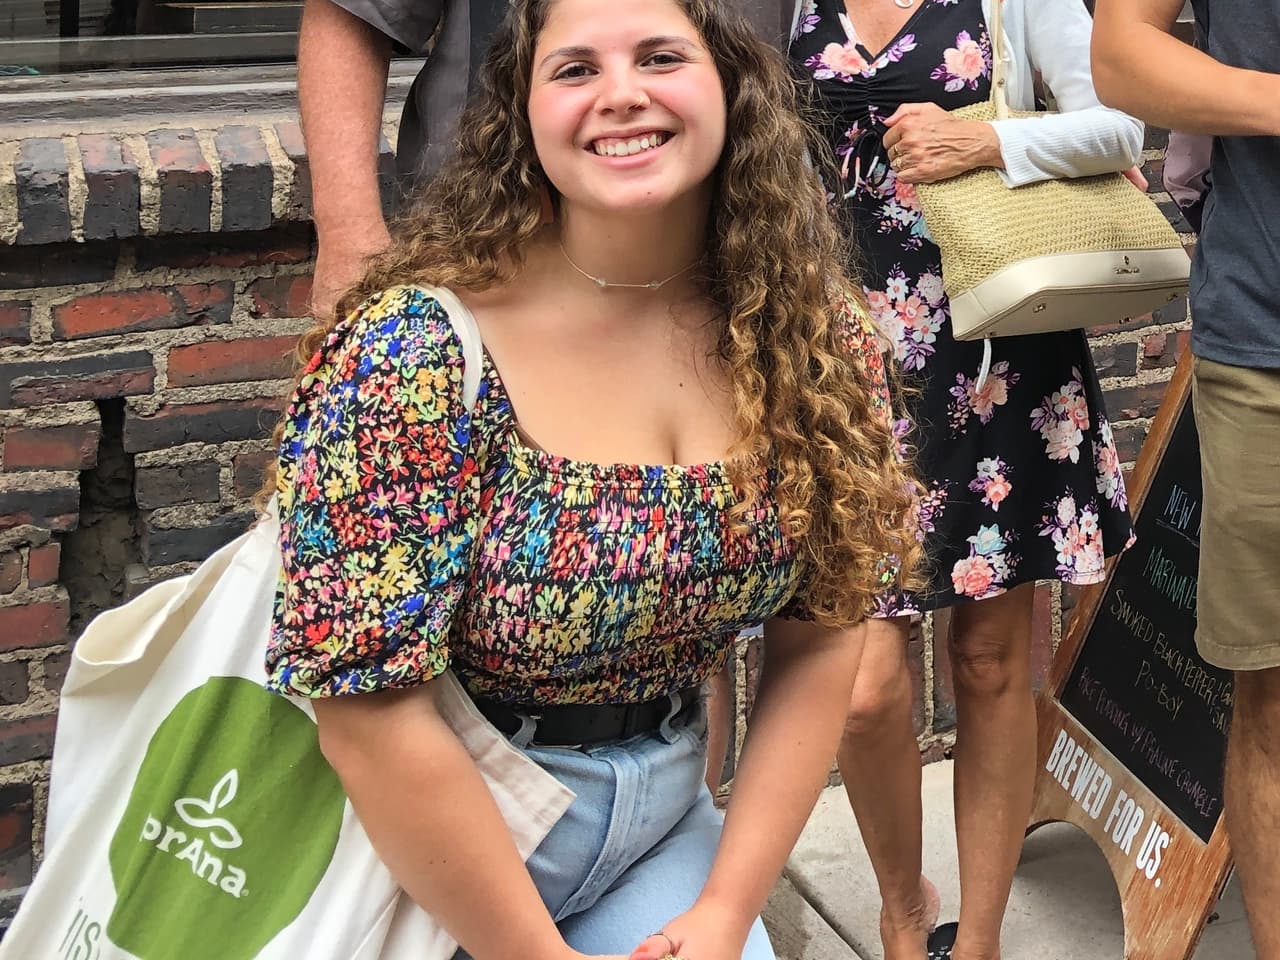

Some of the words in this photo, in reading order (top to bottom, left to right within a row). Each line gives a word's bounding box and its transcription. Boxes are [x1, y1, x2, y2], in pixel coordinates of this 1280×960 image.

[1163, 484, 1197, 530] NEW
[1142, 545, 1199, 619] MARINATE
[1110, 589, 1154, 642] SMOKED
[1152, 632, 1185, 675] BLACK
[1045, 728, 1113, 820] BREWED
[1103, 788, 1145, 857] FOR
[139, 808, 247, 898] prAna
